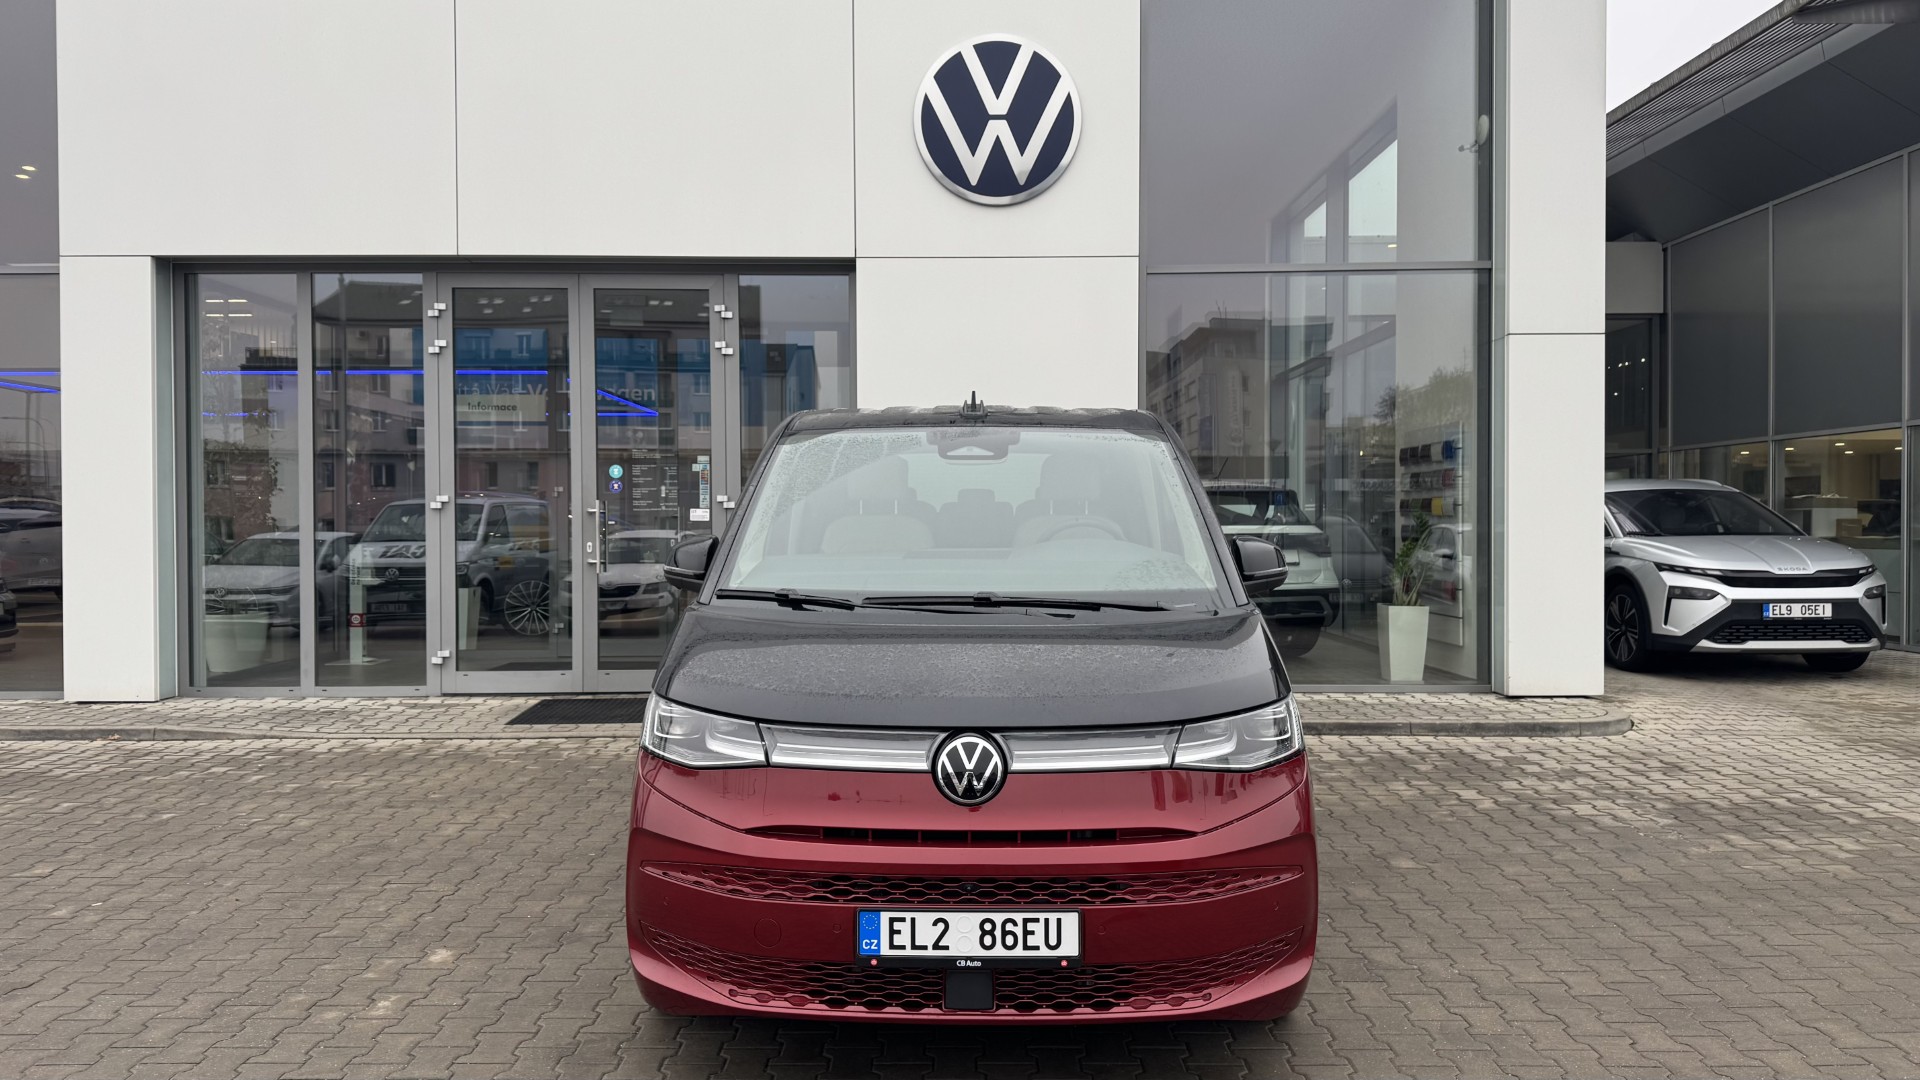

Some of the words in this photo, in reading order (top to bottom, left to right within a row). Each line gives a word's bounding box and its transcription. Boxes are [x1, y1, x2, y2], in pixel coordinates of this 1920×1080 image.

[467, 401, 518, 411] Informace
[1772, 604, 1792, 616] EL9
[1800, 604, 1826, 616] 05EI
[888, 916, 950, 951] EL2
[978, 917, 1062, 951] 86EU
[862, 939, 878, 950] CZ
